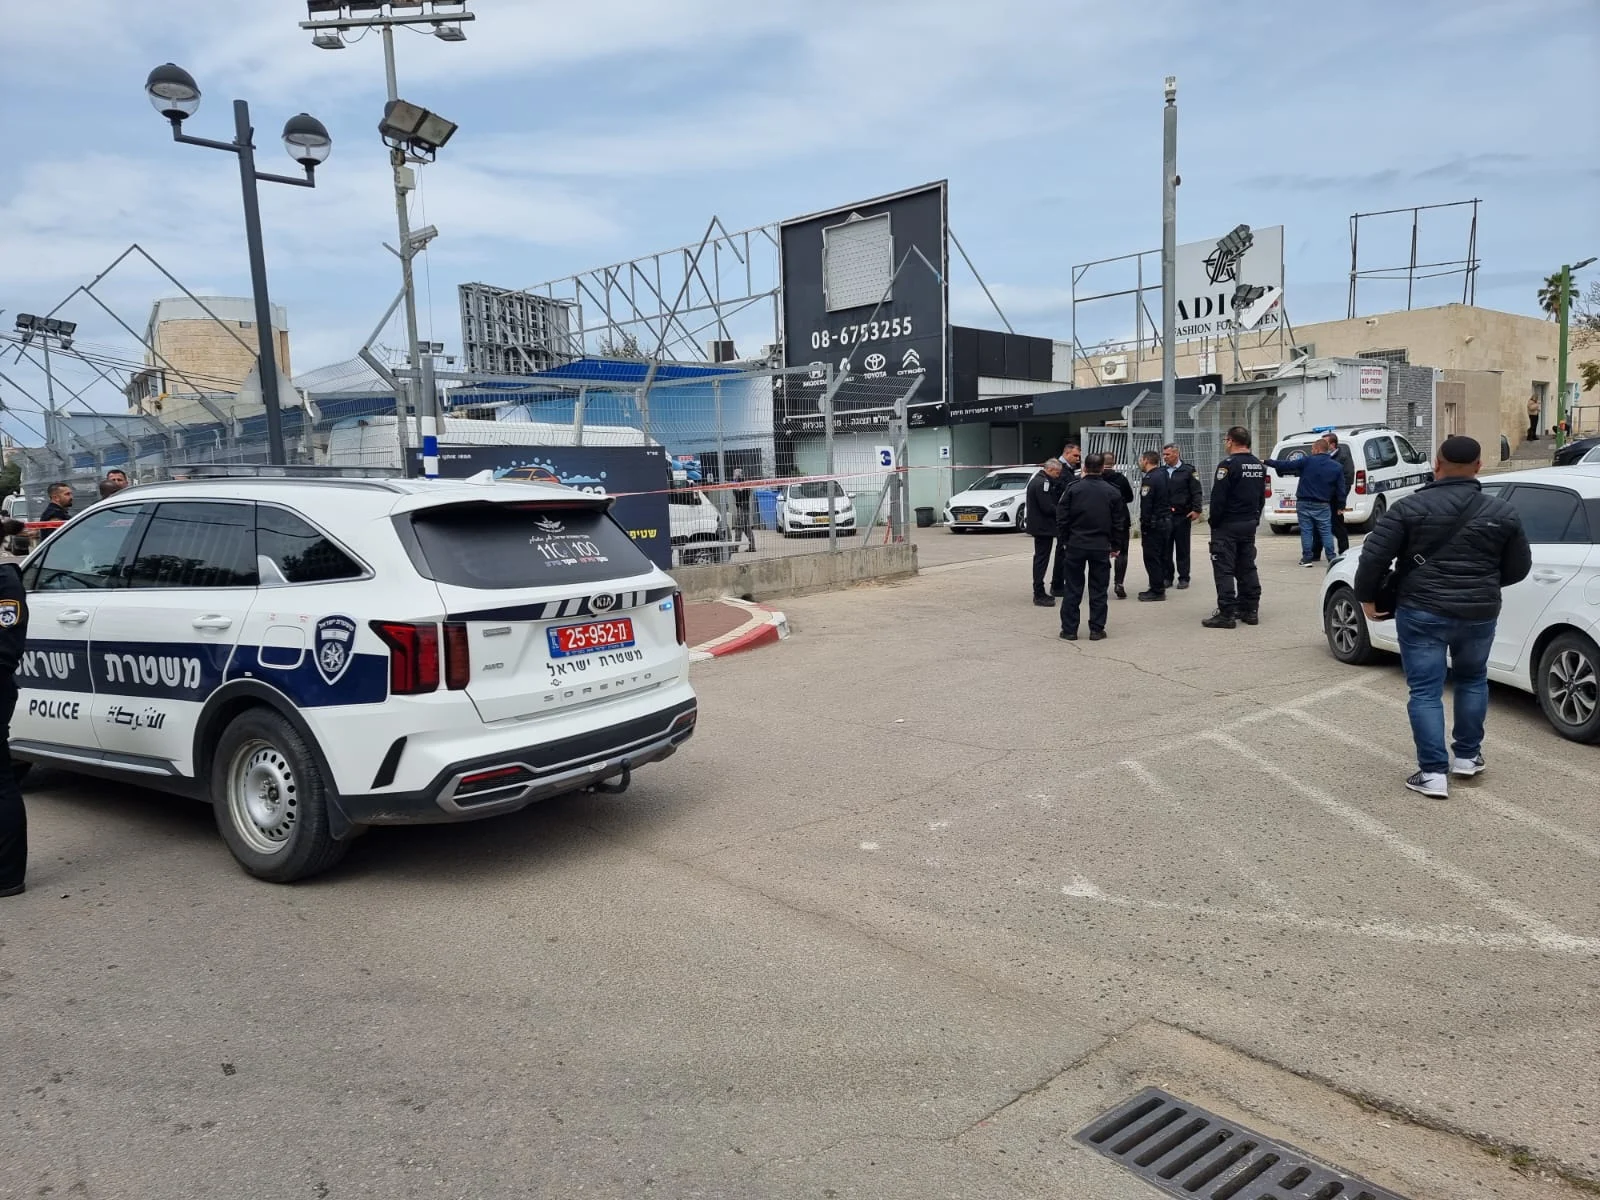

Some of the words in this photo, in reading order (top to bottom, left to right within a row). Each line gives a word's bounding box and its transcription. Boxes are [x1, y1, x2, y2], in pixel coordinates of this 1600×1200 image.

[811, 316, 912, 349] 08-6753255
[863, 371, 887, 379] TOYOTA
[880, 450, 892, 466] 3
[627, 529, 657, 540] שטיפ
[572, 541, 600, 557] 100
[596, 597, 613, 608] KIA
[598, 649, 643, 667] משטרת
[104, 653, 201, 689] משטרת
[546, 658, 591, 677] ישראל
[543, 673, 652, 702] SORENTO
[29, 699, 80, 720] POLICE
[106, 706, 166, 731] الشرطة
